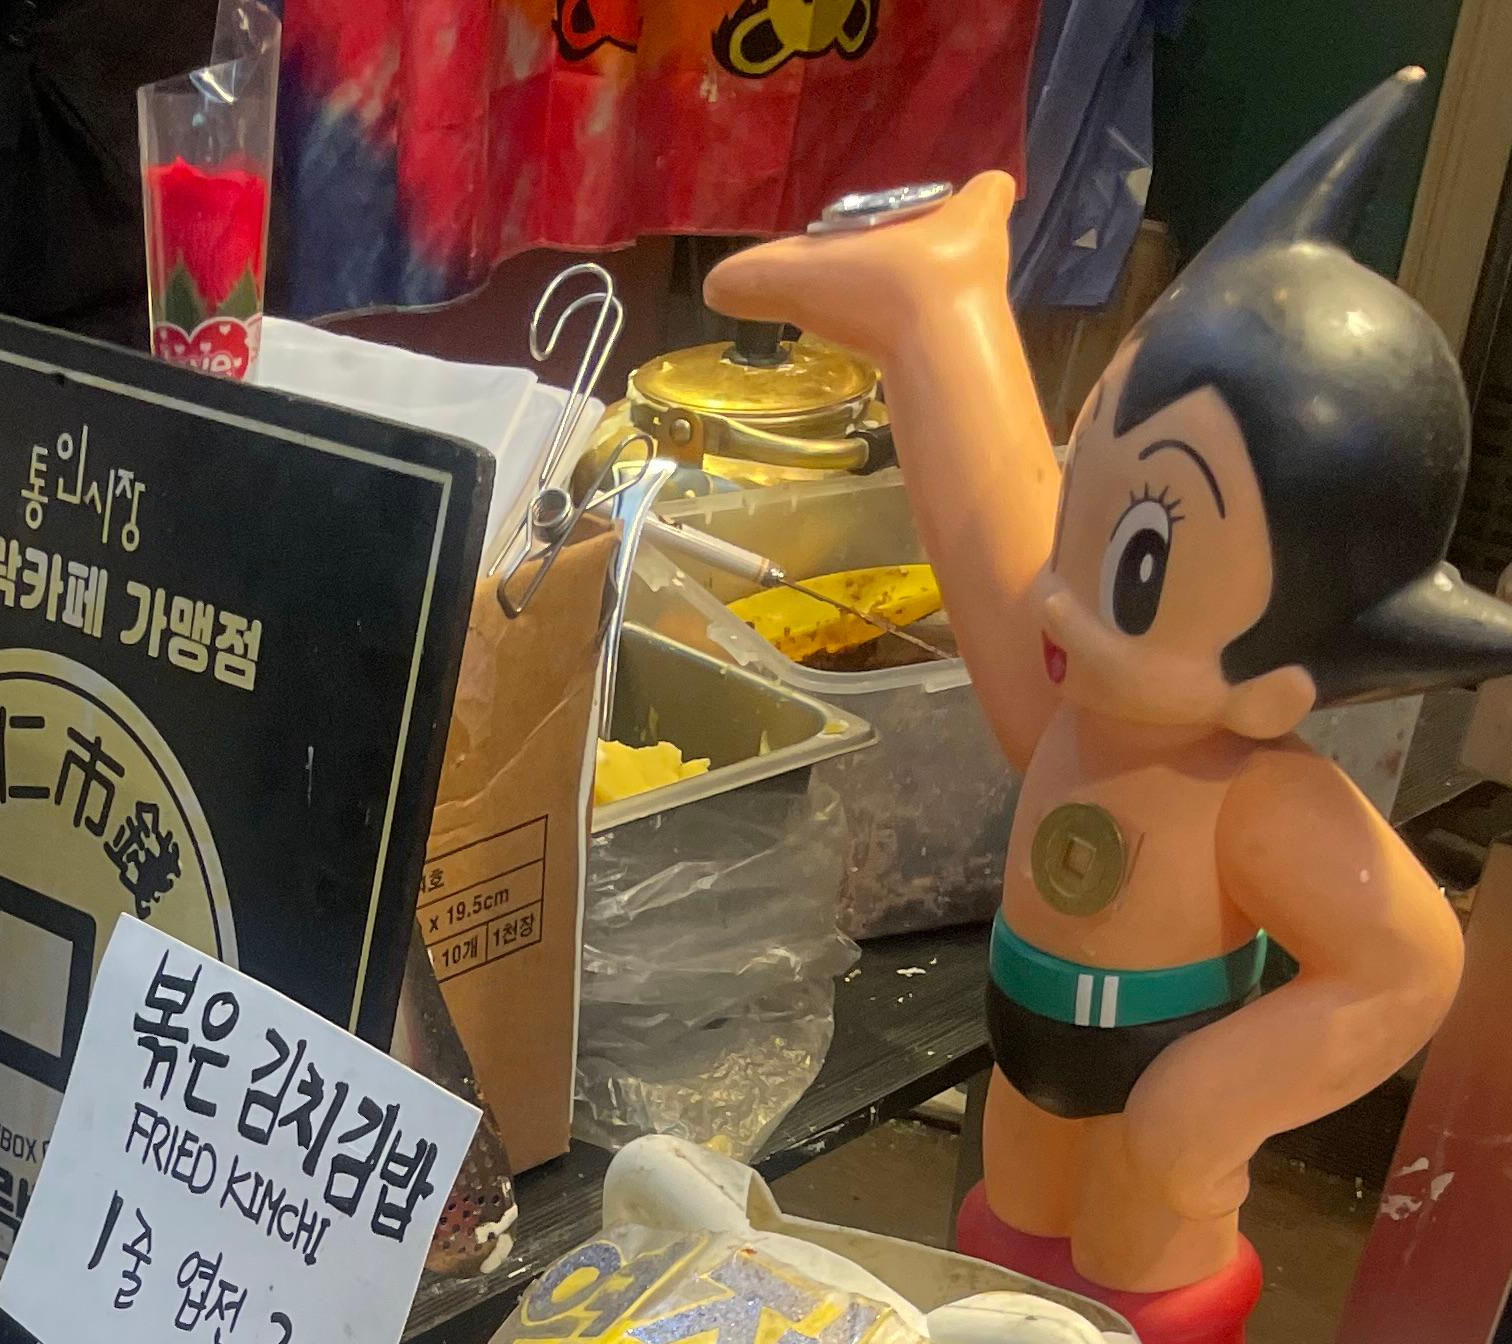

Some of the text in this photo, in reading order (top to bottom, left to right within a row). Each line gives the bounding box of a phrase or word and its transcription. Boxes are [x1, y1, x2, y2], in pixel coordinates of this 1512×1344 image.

[21, 425, 146, 552] 통인시장
[119, 580, 263, 691] 가맹점
[441, 936, 479, 967] 10개
[446, 888, 510, 926] 19.5cm
[492, 912, 536, 947] 1천장
[133, 949, 439, 1243] 볶은 김치김밥
[125, 1101, 332, 1266] FRIED KIMCHI
[87, 1190, 152, 1309] 1줄
